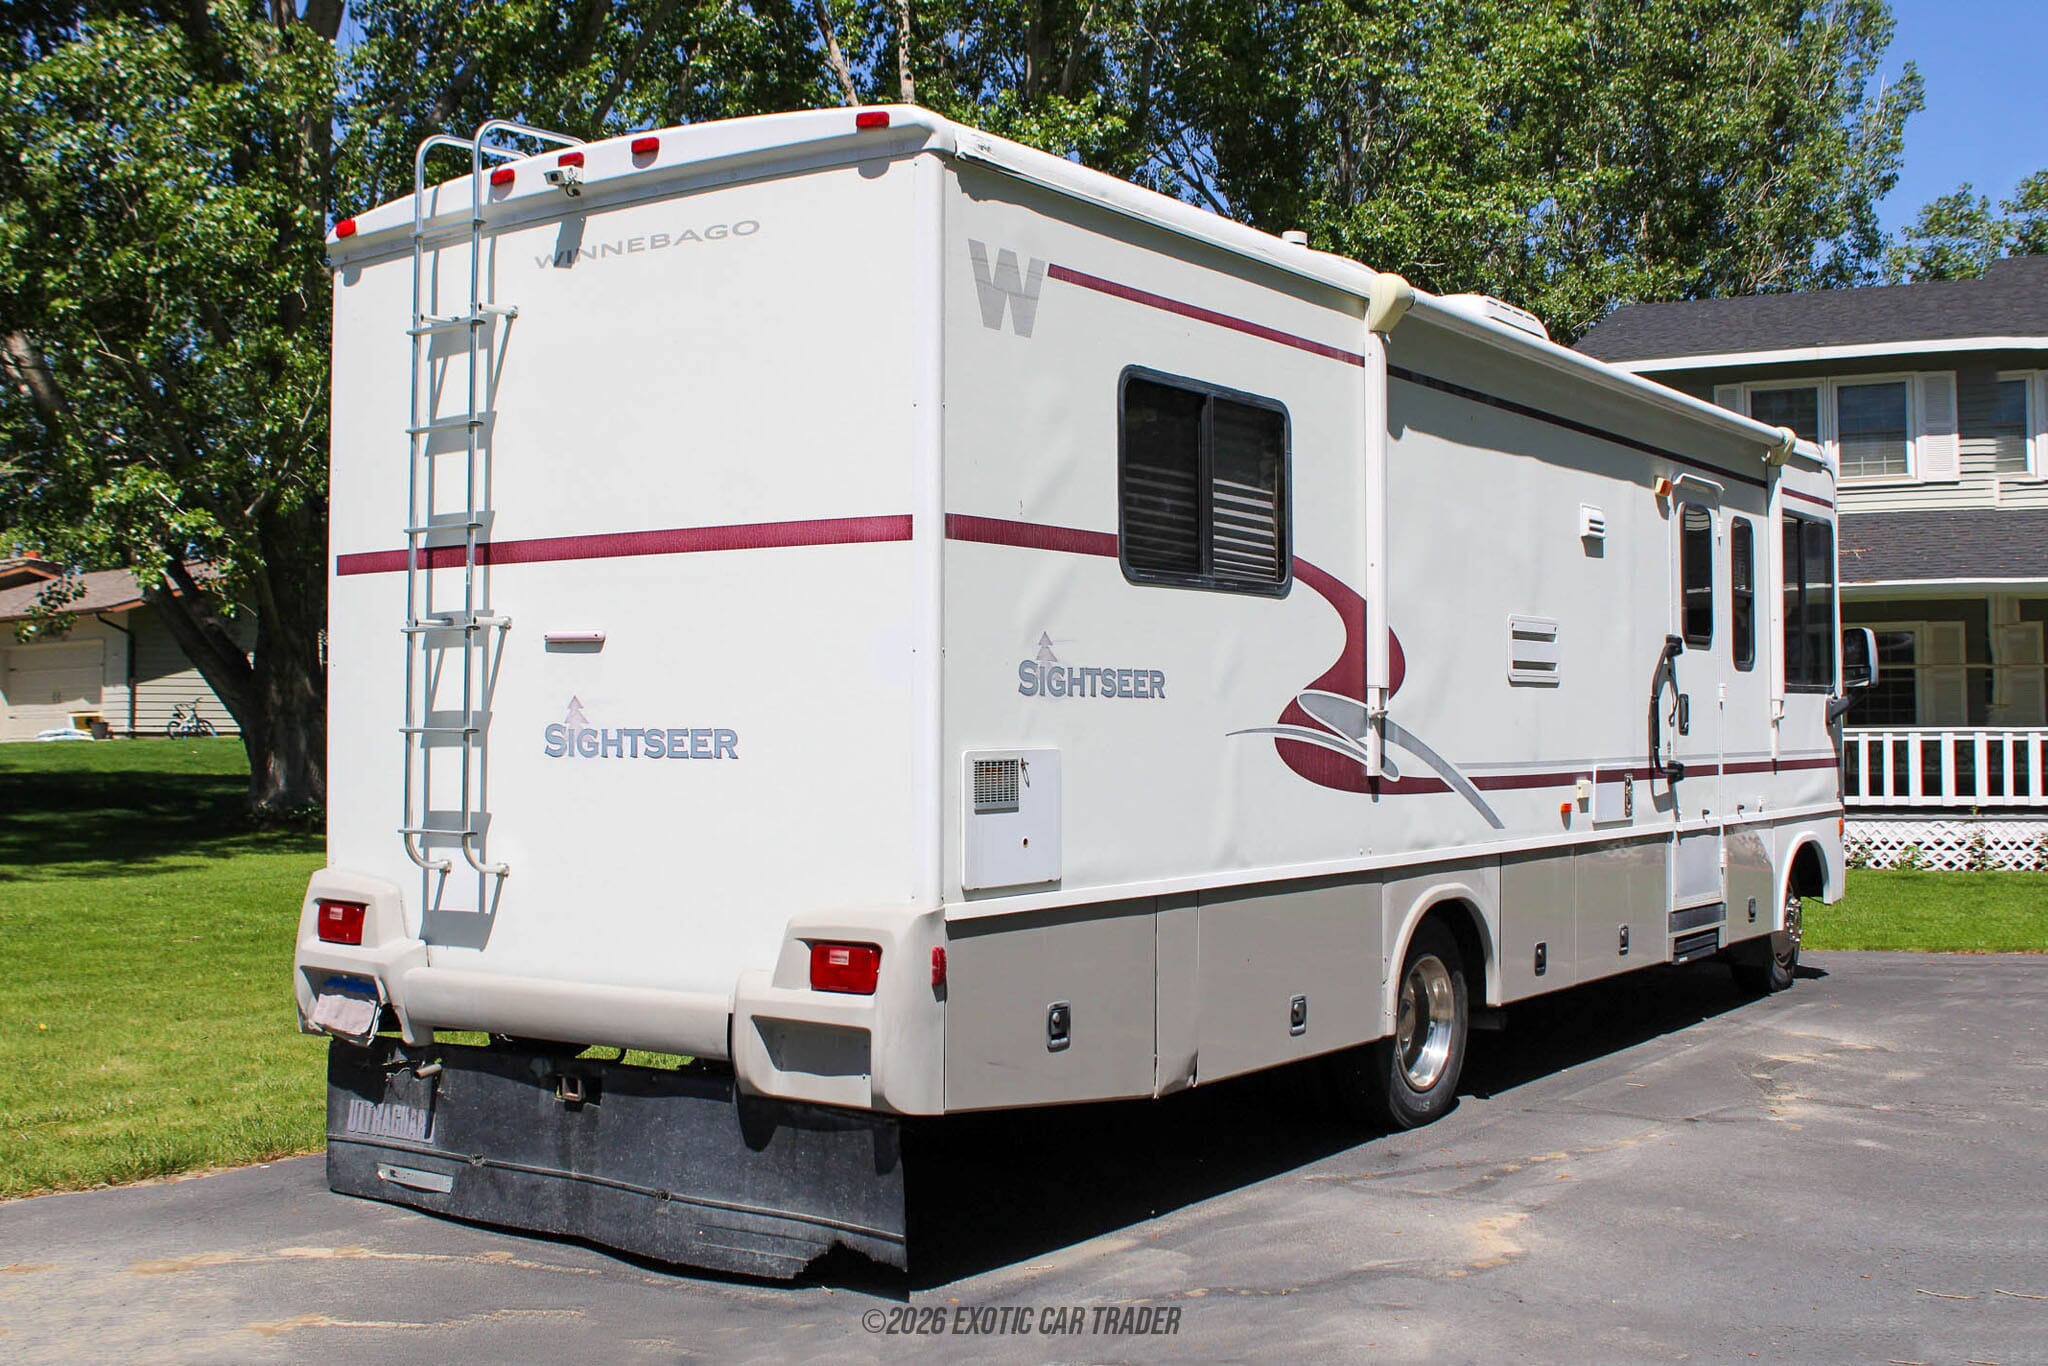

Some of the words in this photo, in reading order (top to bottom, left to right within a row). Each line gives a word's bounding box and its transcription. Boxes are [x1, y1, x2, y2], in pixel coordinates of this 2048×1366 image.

[534, 219, 761, 270] WINNEBAGO
[1018, 659, 1166, 699] SIGHTSEER
[544, 723, 739, 760] SIGHTSEER
[347, 1099, 437, 1144] ULTRAGUAR
